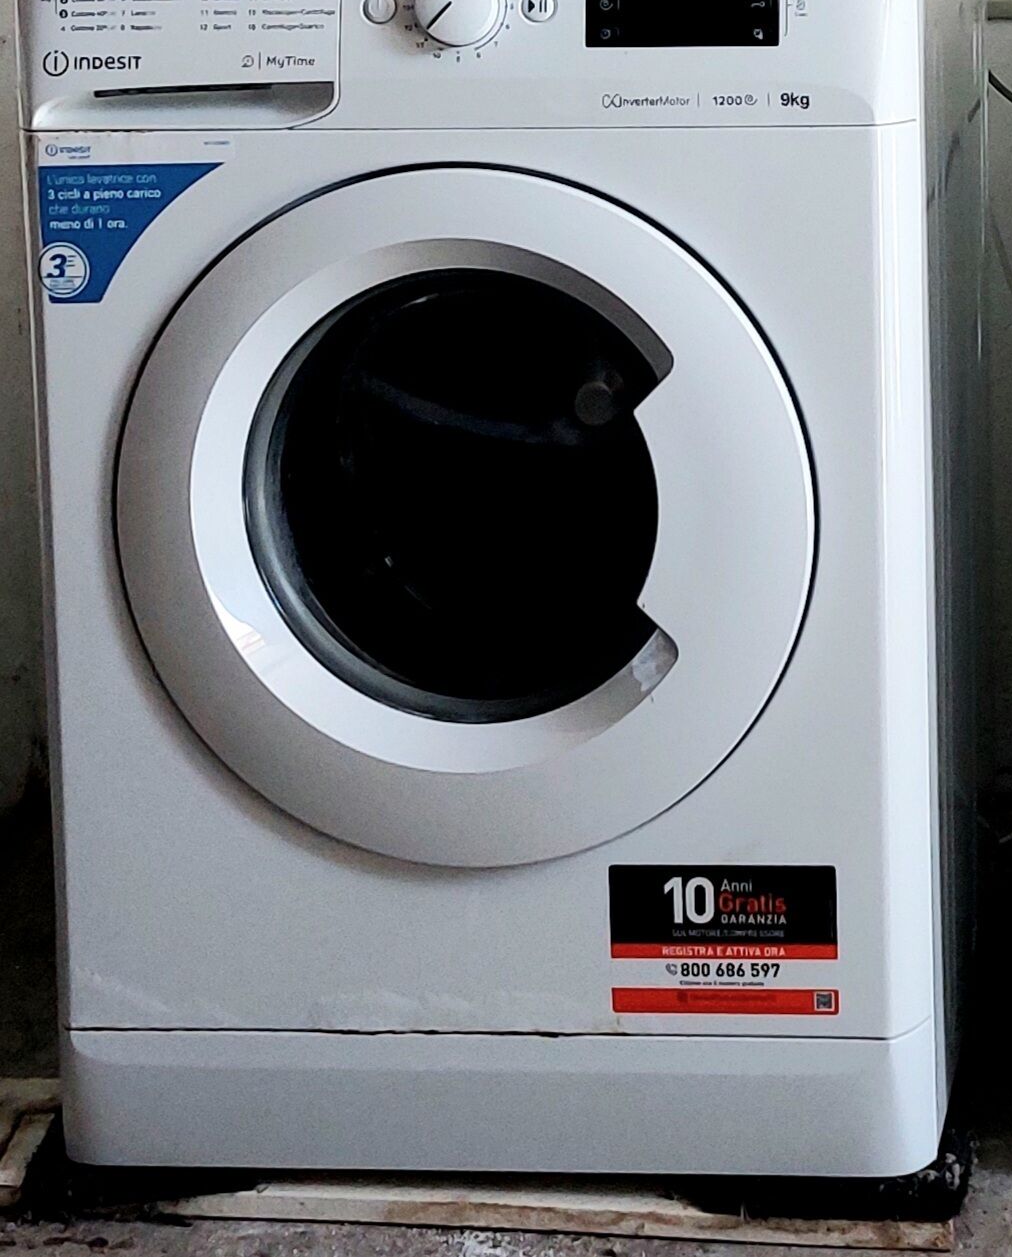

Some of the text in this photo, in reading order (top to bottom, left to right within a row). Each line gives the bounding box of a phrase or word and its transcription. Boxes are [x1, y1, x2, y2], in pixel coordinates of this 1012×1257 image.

[266, 55, 315, 68] MyTime
[712, 95, 743, 106] 1200
[780, 92, 811, 110] 9kg
[136, 175, 157, 184] con
[48, 189, 161, 202] 3 cicli a pieno carico
[49, 204, 110, 215] che durano
[50, 220, 80, 229] meno
[83, 218, 94, 230] di
[107, 220, 128, 229] ora.
[46, 253, 68, 278] 3
[663, 876, 753, 925] 10 Anni
[718, 893, 787, 913] Gratis
[721, 914, 788, 925] GARANZIA
[662, 946, 786, 957] REGISTRA E ATTIVA ORA
[681, 962, 780, 978] 800 686 597
